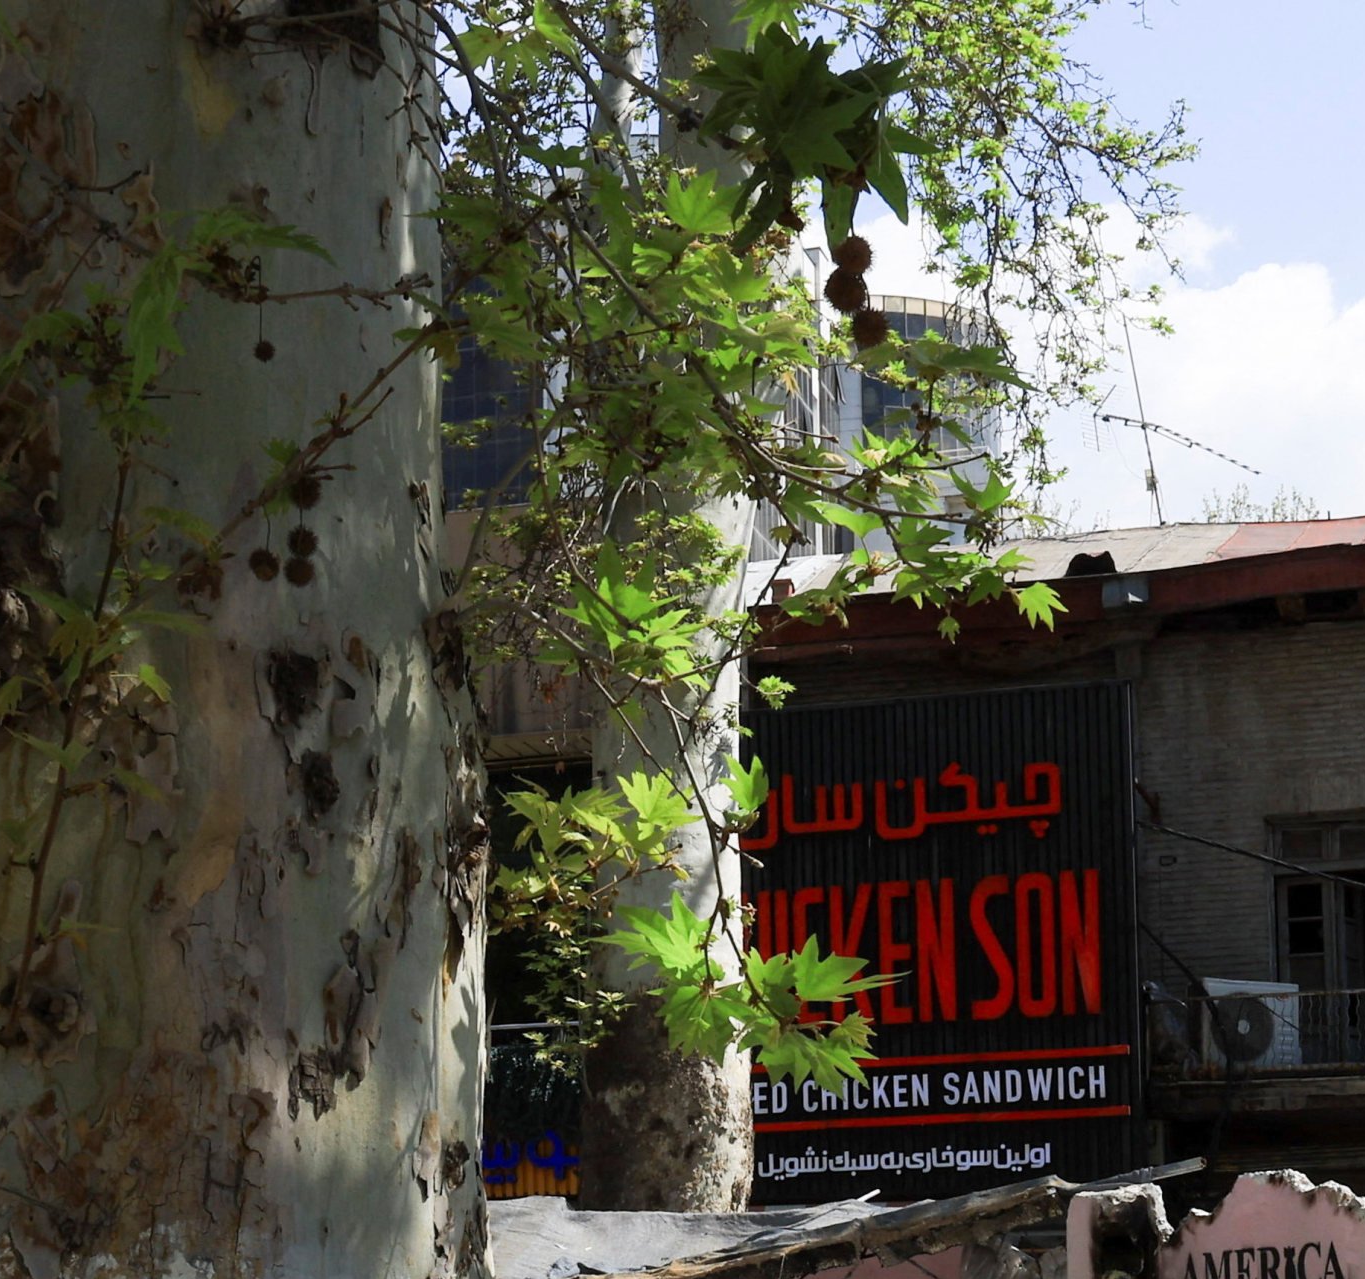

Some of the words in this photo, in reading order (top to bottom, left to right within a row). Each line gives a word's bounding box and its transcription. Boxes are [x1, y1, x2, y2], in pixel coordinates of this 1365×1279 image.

[875, 761, 1061, 840] چیکن
[969, 868, 1101, 1021] SON
[802, 1073, 930, 1114] CHICKEN
[943, 1065, 1107, 1105] SANDWICH
[758, 1146, 828, 1181] نشویل
[880, 1151, 905, 1175] به
[905, 1145, 992, 1173] سوخاری
[993, 1142, 1051, 1173] اولین
